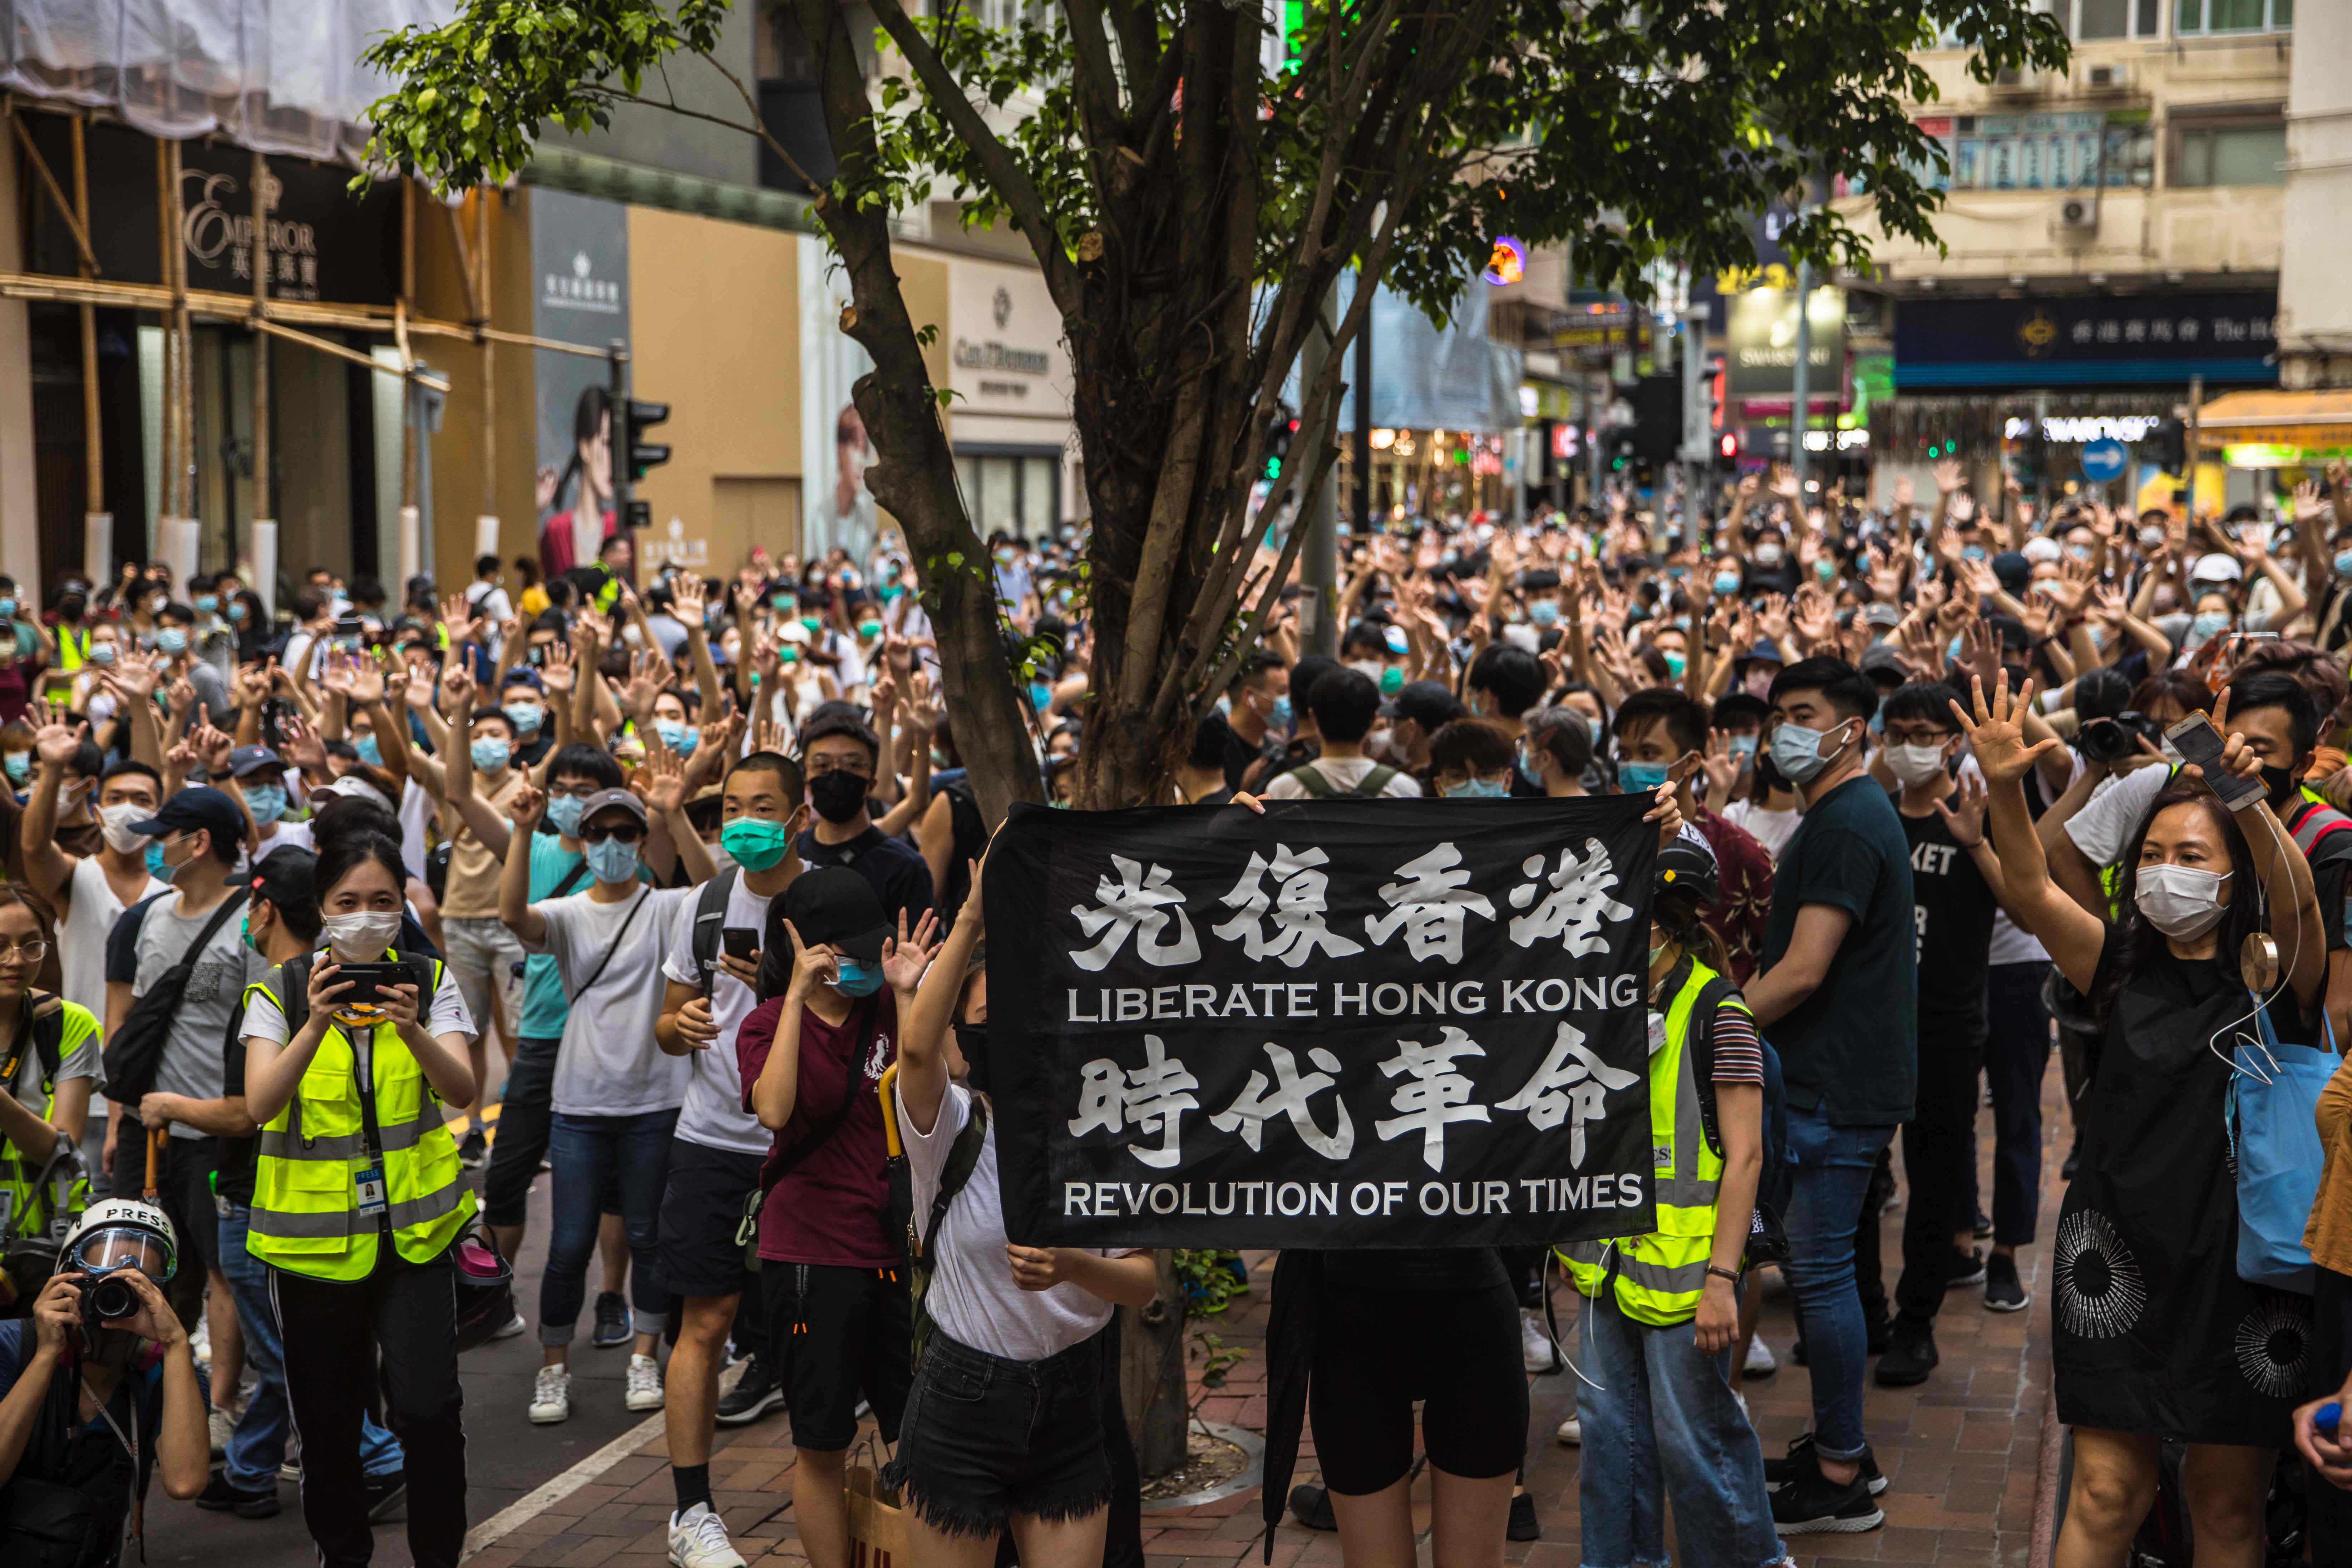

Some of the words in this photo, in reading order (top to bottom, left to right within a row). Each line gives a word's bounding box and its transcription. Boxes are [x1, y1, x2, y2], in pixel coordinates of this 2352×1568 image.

[1069, 838, 1633, 971] 光復香港
[1068, 982, 1318, 1021] LIBERATE
[1333, 981, 1486, 1016] HONG
[1502, 974, 1638, 1013] KONG
[1068, 1021, 1640, 1173] 時代革命
[356, 1170, 378, 1179] PRESS
[1064, 1181, 1339, 1217] REVOLUTION
[1351, 1181, 1408, 1215] OF
[1420, 1181, 1511, 1216] OUR
[1520, 1173, 1642, 1212] TIMES
[106, 1208, 171, 1234] PRESS
